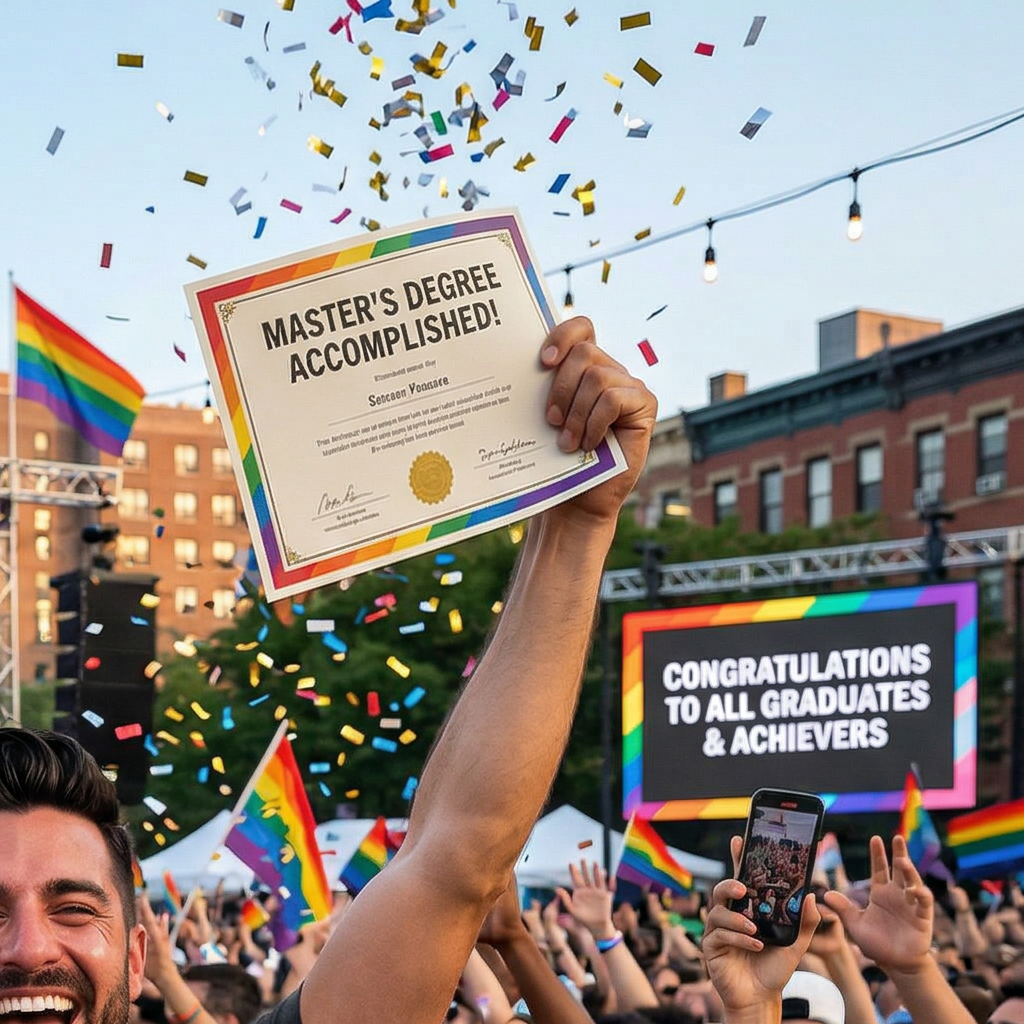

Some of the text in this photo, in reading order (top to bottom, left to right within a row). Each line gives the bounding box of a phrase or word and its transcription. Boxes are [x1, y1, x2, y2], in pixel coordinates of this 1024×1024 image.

[262, 263, 502, 350] MASTER'S DEGREE
[290, 299, 502, 384] ACCOMPLISHED!
[663, 643, 931, 692] CONGRATULATIONS
[664, 679, 931, 725] TO ALL GRADUATES
[702, 717, 889, 758] & ACHIEVERS
